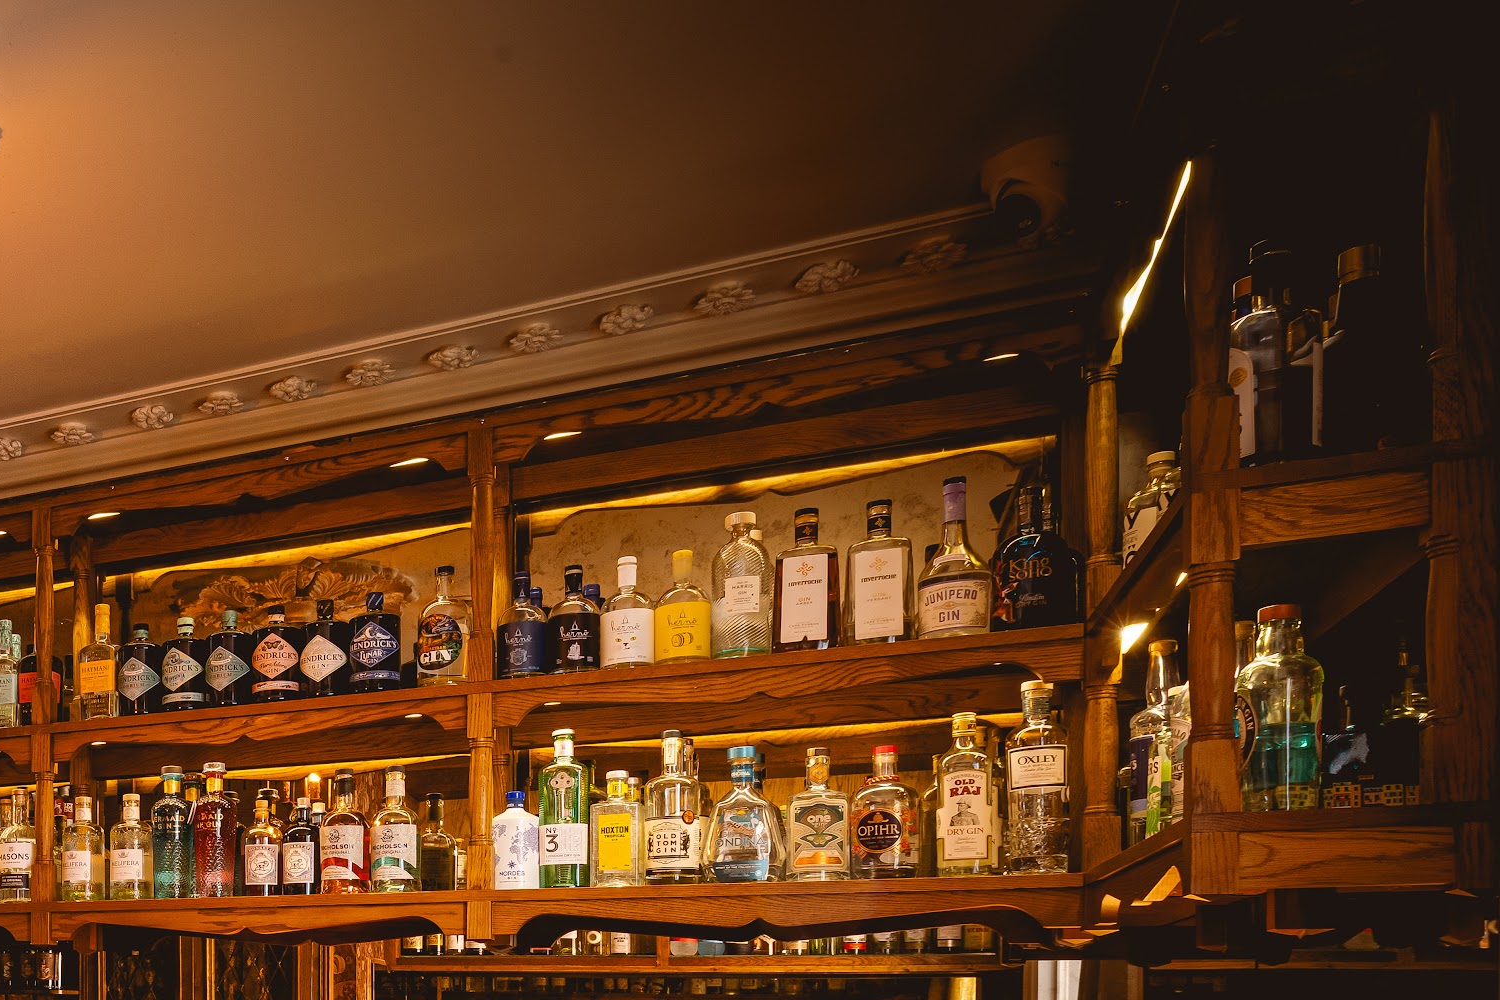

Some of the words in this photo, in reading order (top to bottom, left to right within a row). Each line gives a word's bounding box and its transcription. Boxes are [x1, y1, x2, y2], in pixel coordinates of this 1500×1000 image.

[924, 589, 978, 606] JUNIPERO
[939, 609, 960, 623] GIN
[253, 652, 298, 663] HENDRICK'S
[360, 649, 383, 662] LUNAR
[420, 648, 454, 666] GIN
[164, 664, 199, 674] NDRICK'S
[210, 663, 244, 673] NDRICK'S
[121, 674, 156, 683] NDRICK'S
[1018, 754, 1058, 765] OXLEY
[954, 778, 976, 786] OLD
[949, 784, 982, 798] RAJ
[807, 815, 831, 824] one
[601, 826, 629, 835] HOXTON
[858, 823, 900, 837] OPIHR
[947, 828, 966, 836] DRY
[966, 827, 984, 835] GIN
[546, 834, 559, 853] 3
[715, 837, 766, 848] ONDINA
